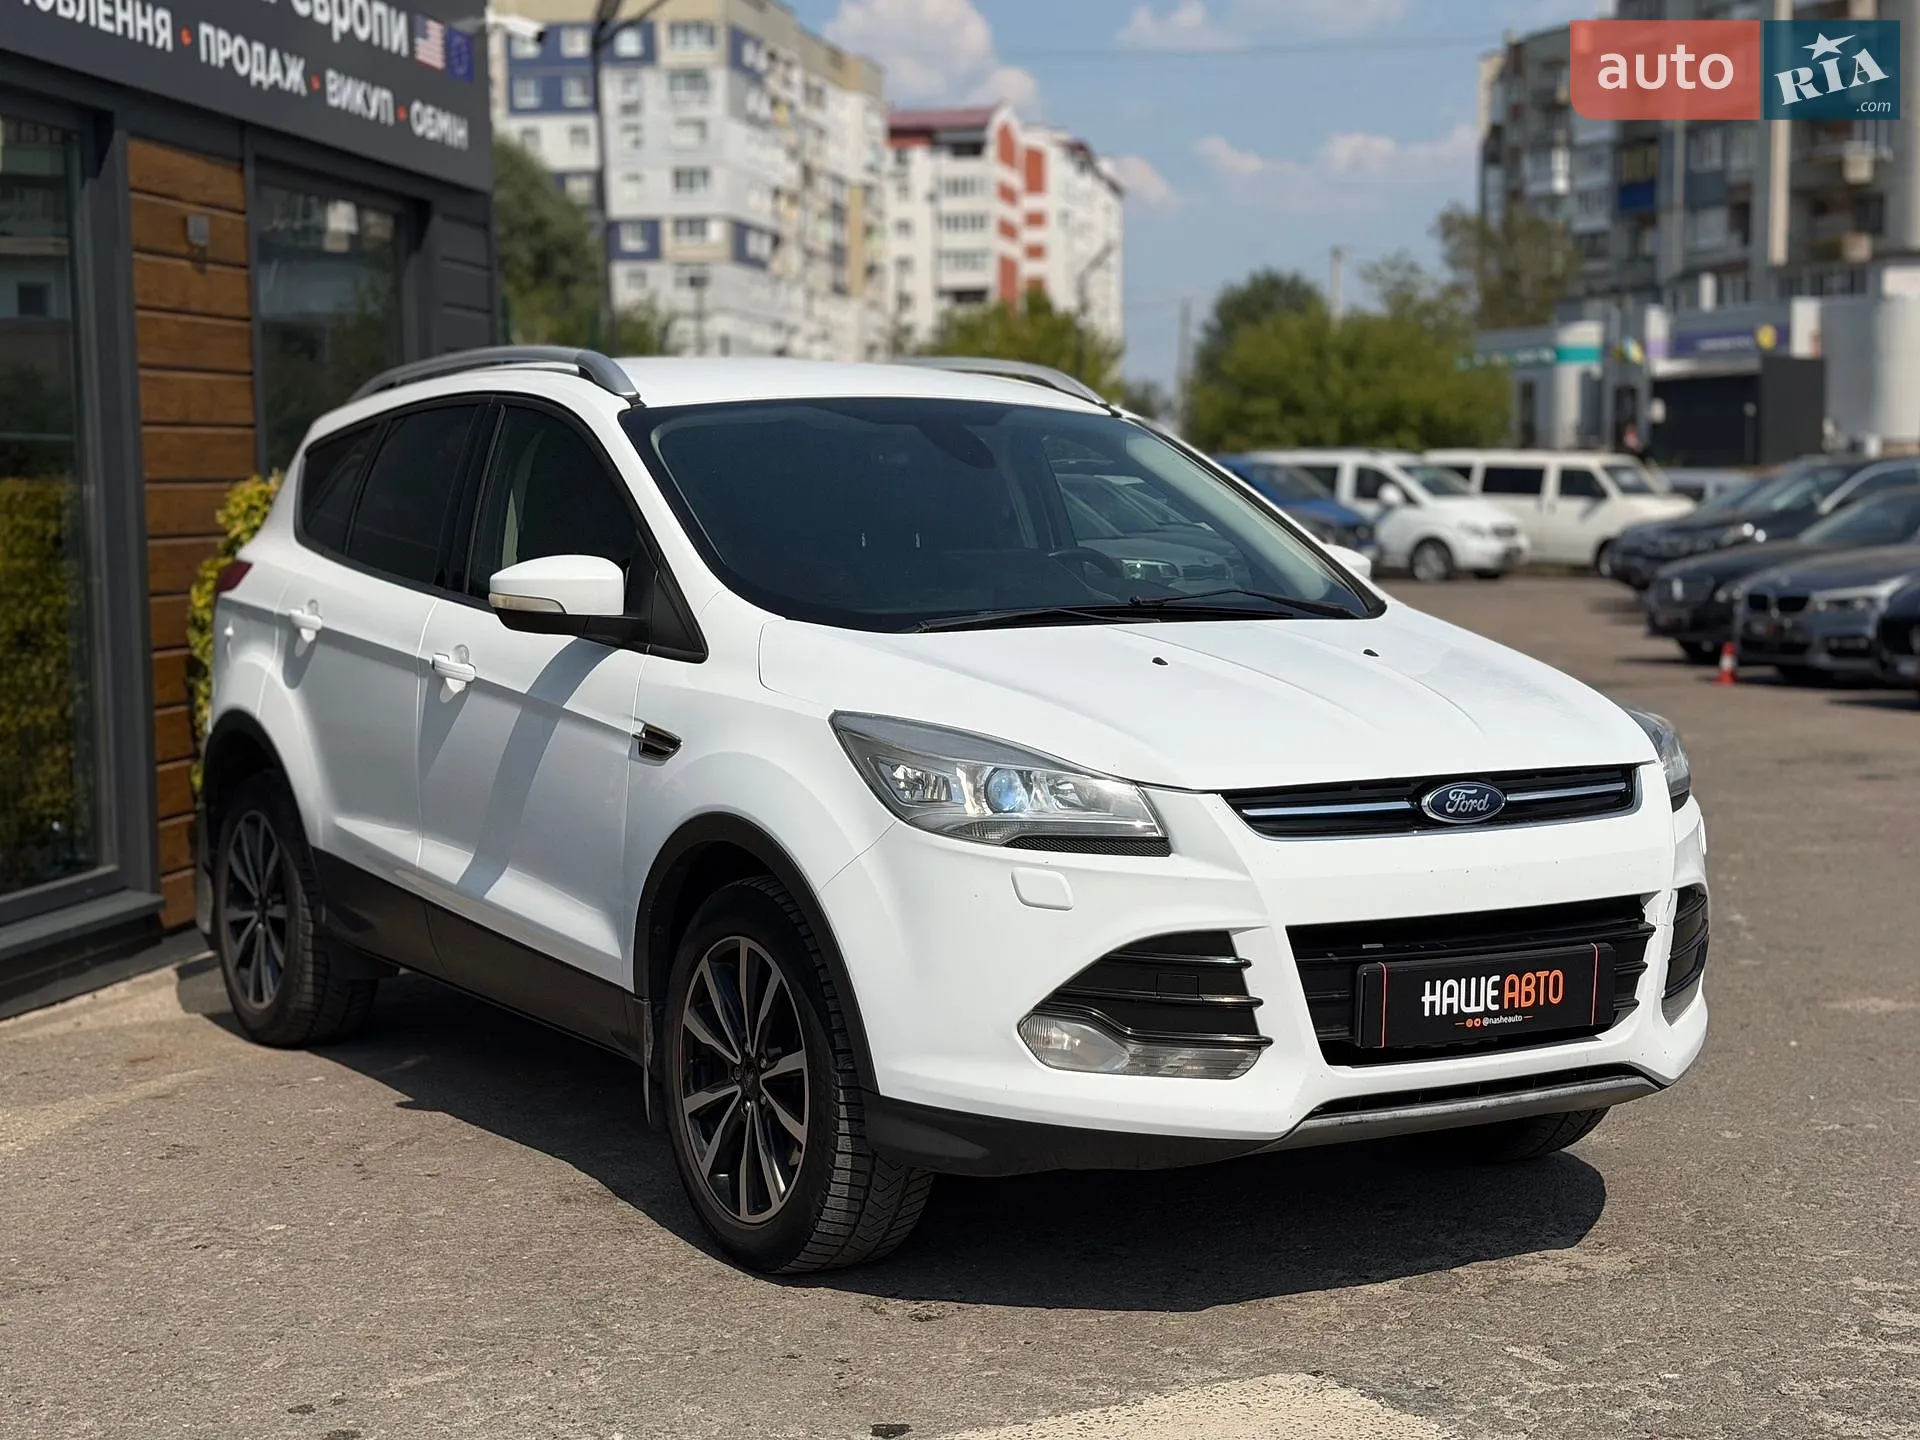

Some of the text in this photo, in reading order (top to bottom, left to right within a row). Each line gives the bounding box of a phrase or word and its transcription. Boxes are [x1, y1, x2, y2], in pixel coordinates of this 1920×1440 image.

[199, 22, 306, 96] ПРОДАЖ
[325, 68, 395, 126] ВИКУП
[410, 98, 469, 151] ОБМІН
[1445, 788, 1490, 813] Ford
[1482, 1014, 1523, 1027] @nasheauto
